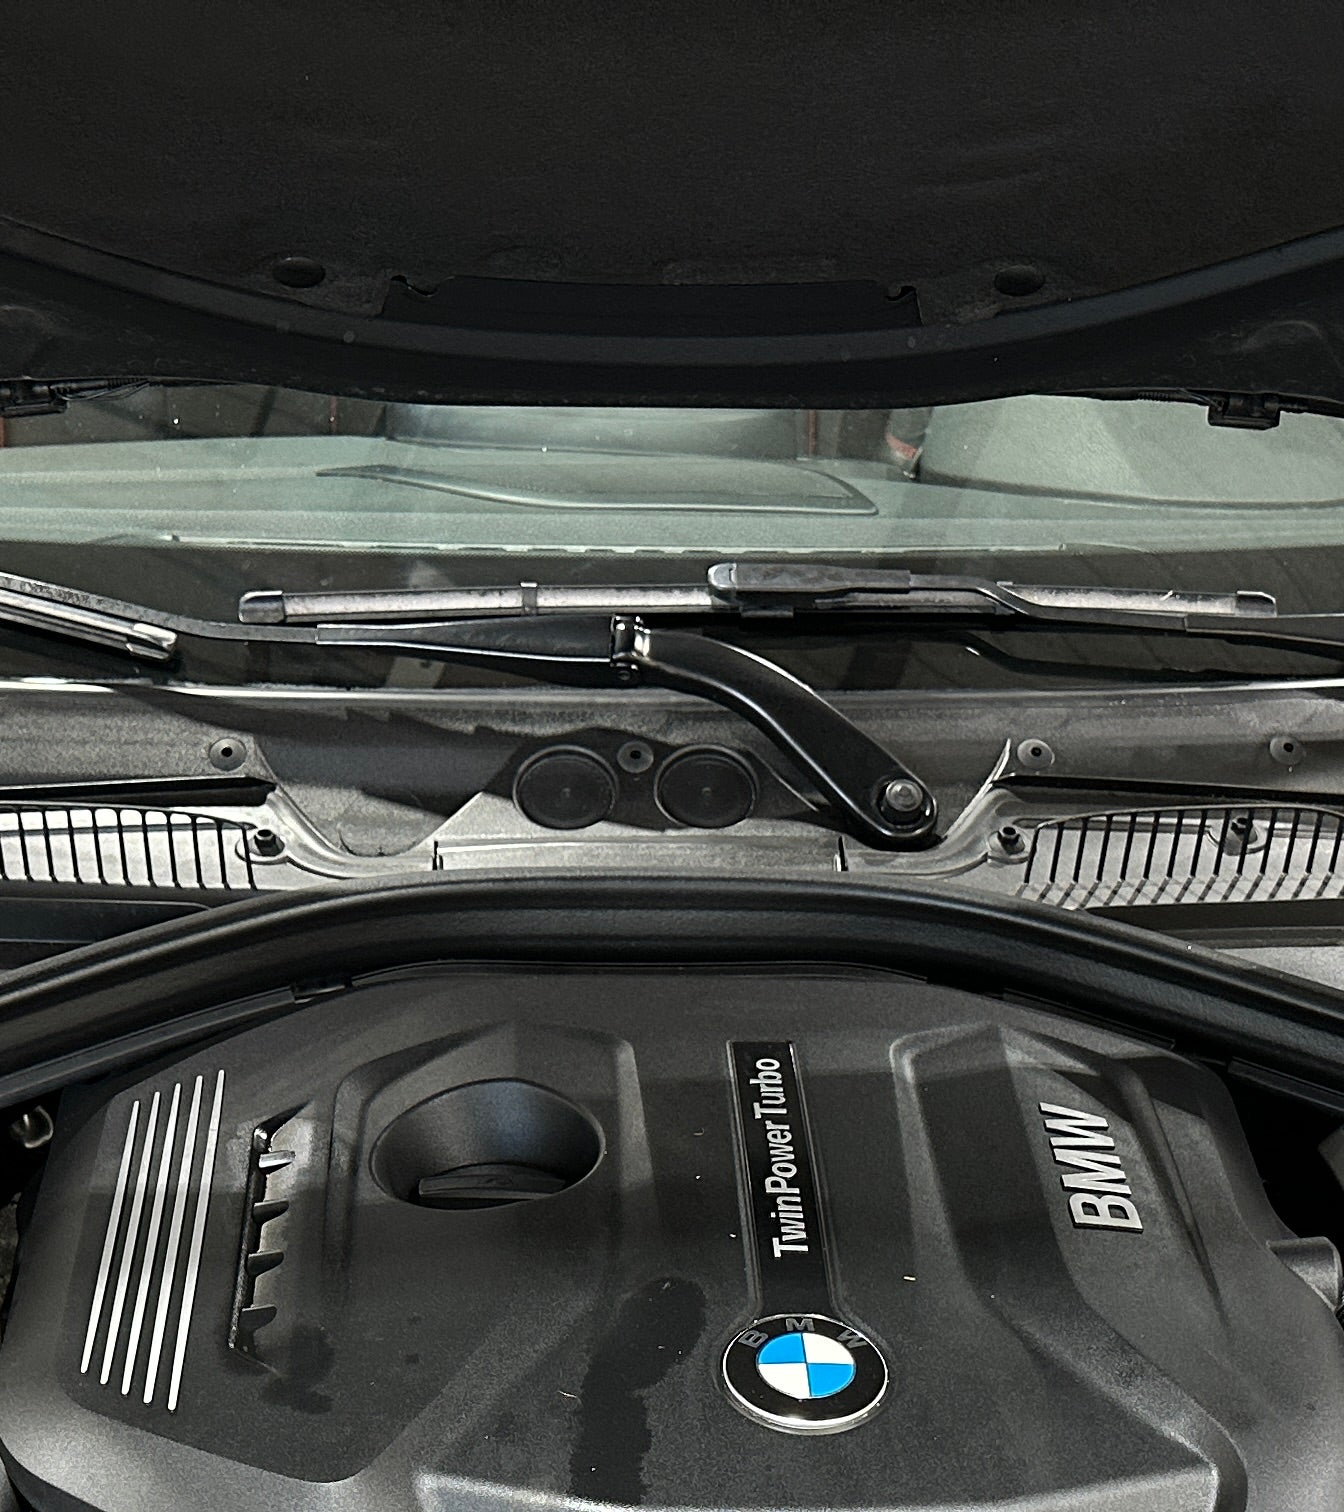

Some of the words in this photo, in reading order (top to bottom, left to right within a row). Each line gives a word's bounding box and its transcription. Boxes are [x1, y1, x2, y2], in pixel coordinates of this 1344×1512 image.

[749, 1057, 788, 1120] Turbo
[764, 1120, 809, 1258] TwinPower
[1038, 1102, 1143, 1231] BMW
[739, 1317, 868, 1349] BMW
